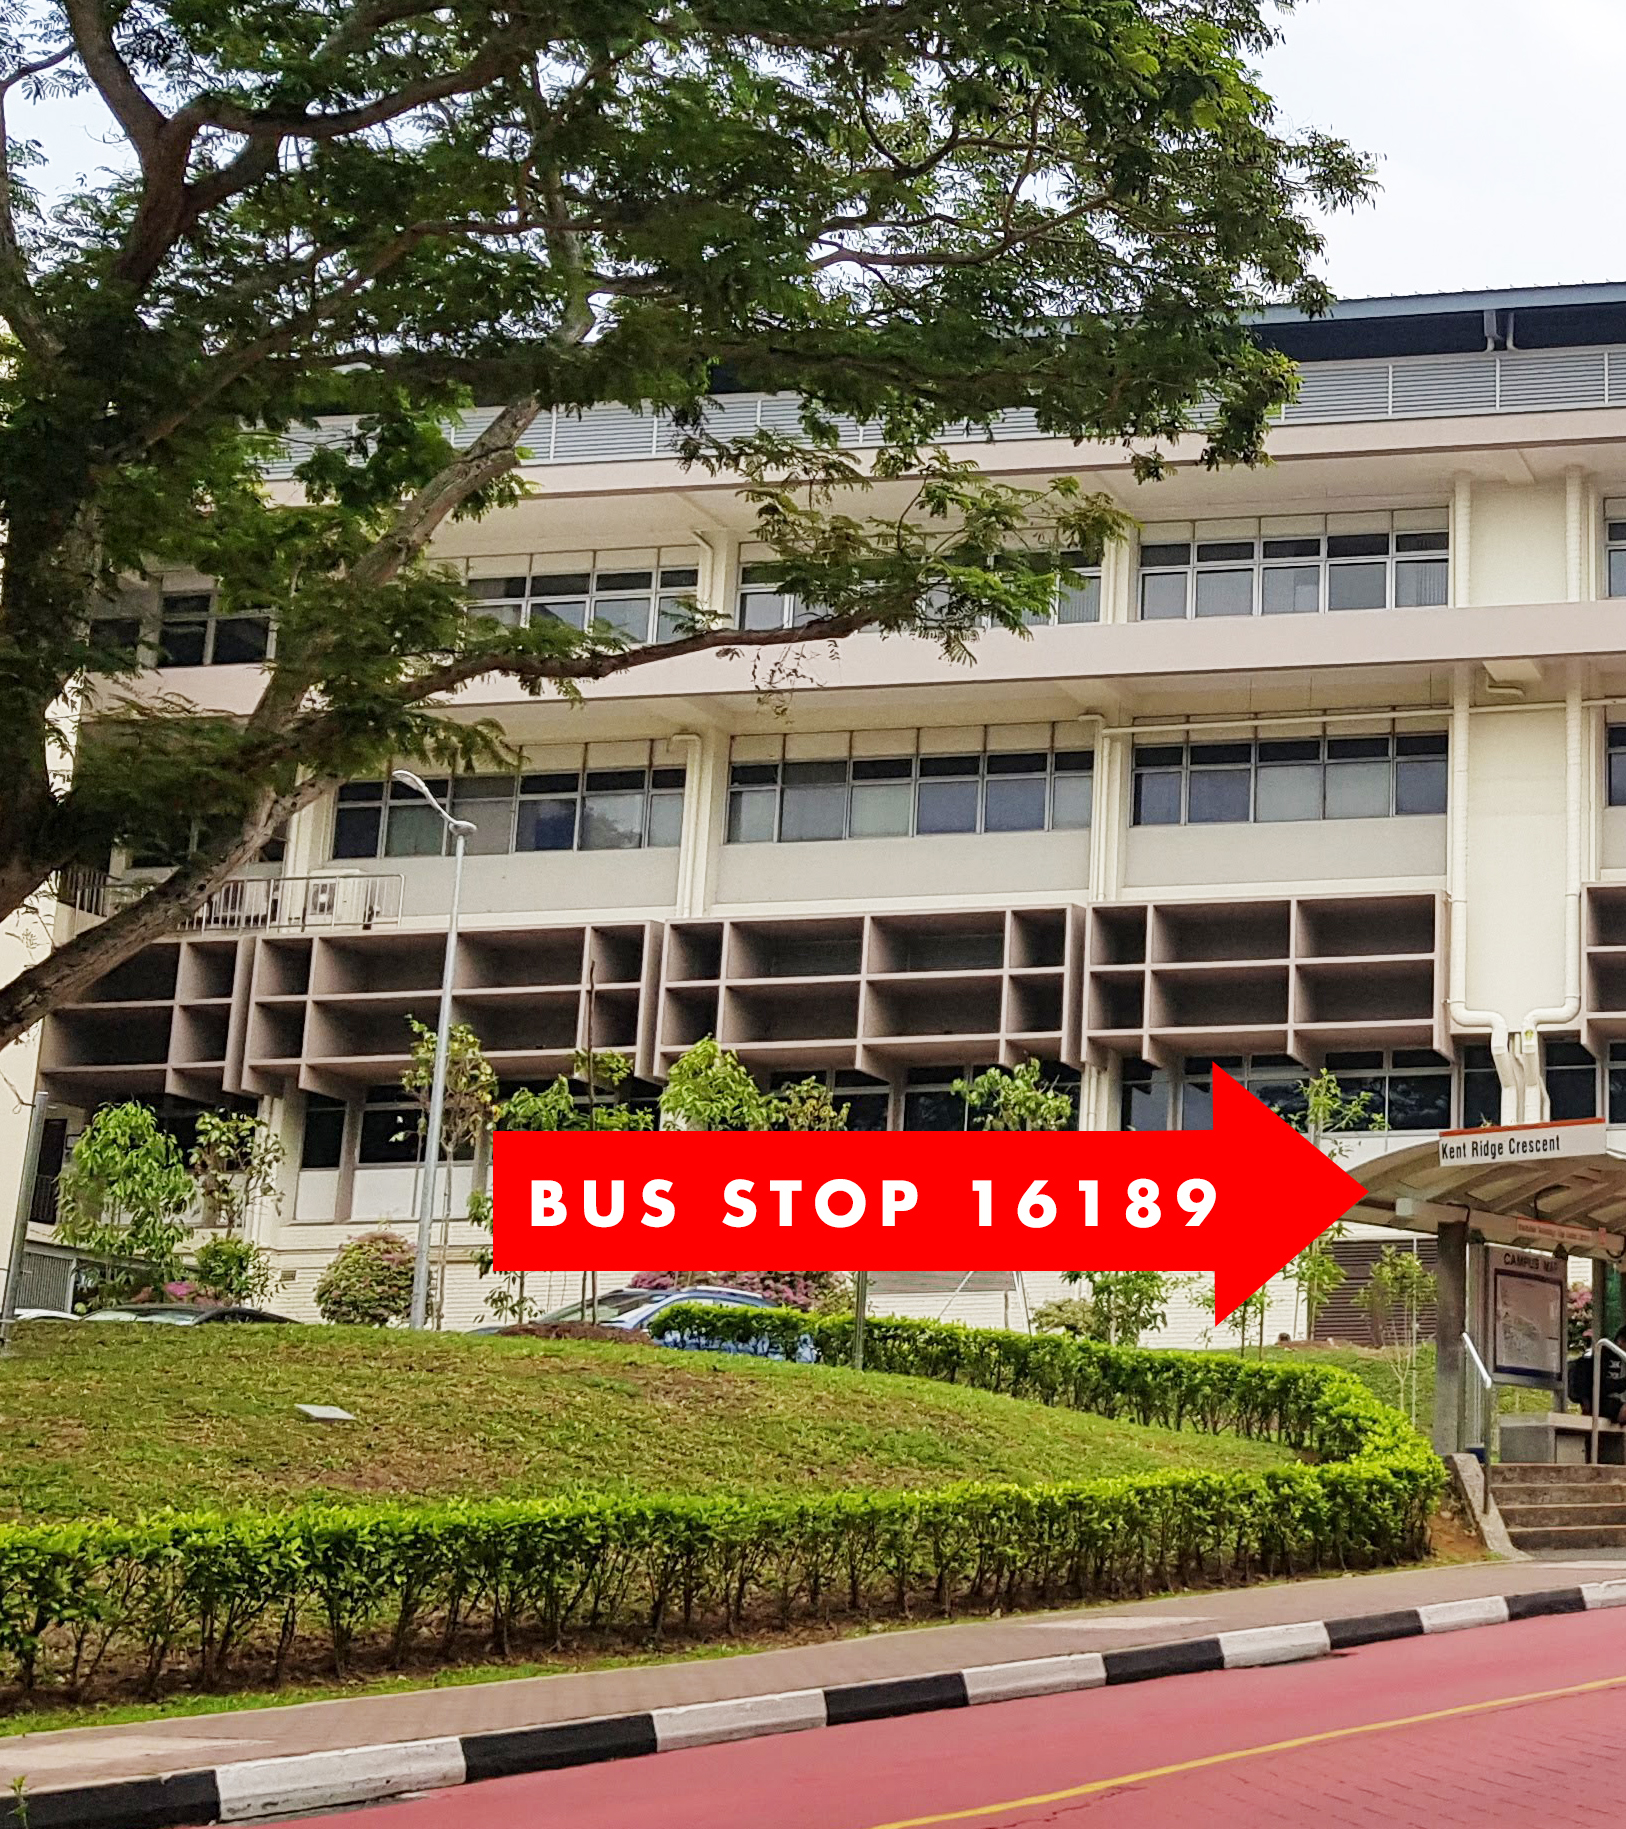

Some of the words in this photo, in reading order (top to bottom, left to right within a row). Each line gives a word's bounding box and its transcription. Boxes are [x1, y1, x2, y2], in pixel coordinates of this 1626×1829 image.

[1441, 1142, 1467, 1160] Kent
[1471, 1140, 1504, 1160] Ridge
[1508, 1134, 1560, 1155] Crescent
[1503, 1252, 1540, 1270] CAMPUS
